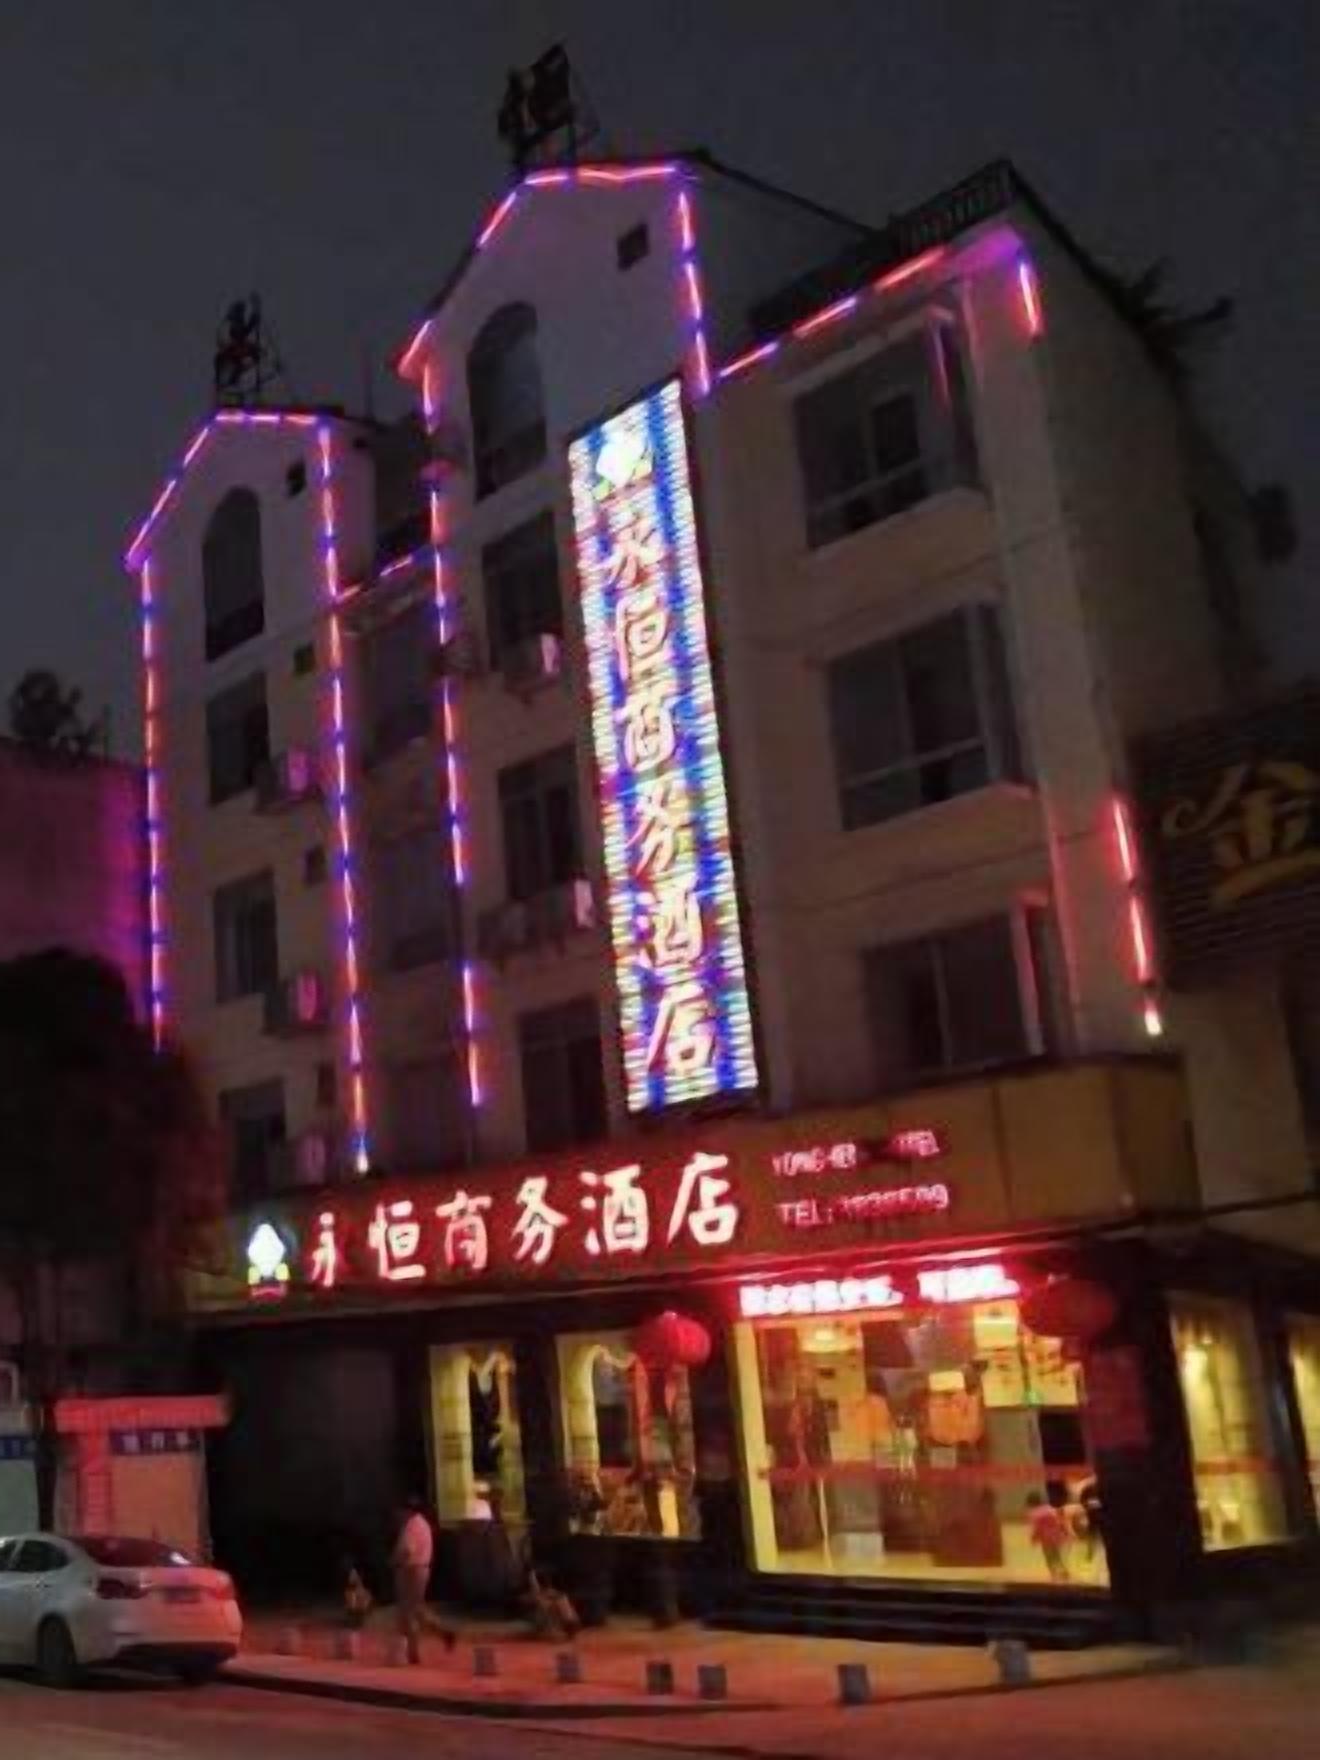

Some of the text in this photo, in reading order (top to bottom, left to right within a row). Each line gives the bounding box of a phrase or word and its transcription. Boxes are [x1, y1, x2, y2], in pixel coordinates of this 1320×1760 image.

[602, 500, 718, 1076] 永恒商务酒店
[311, 1151, 740, 1288] 永恒商务酒店
